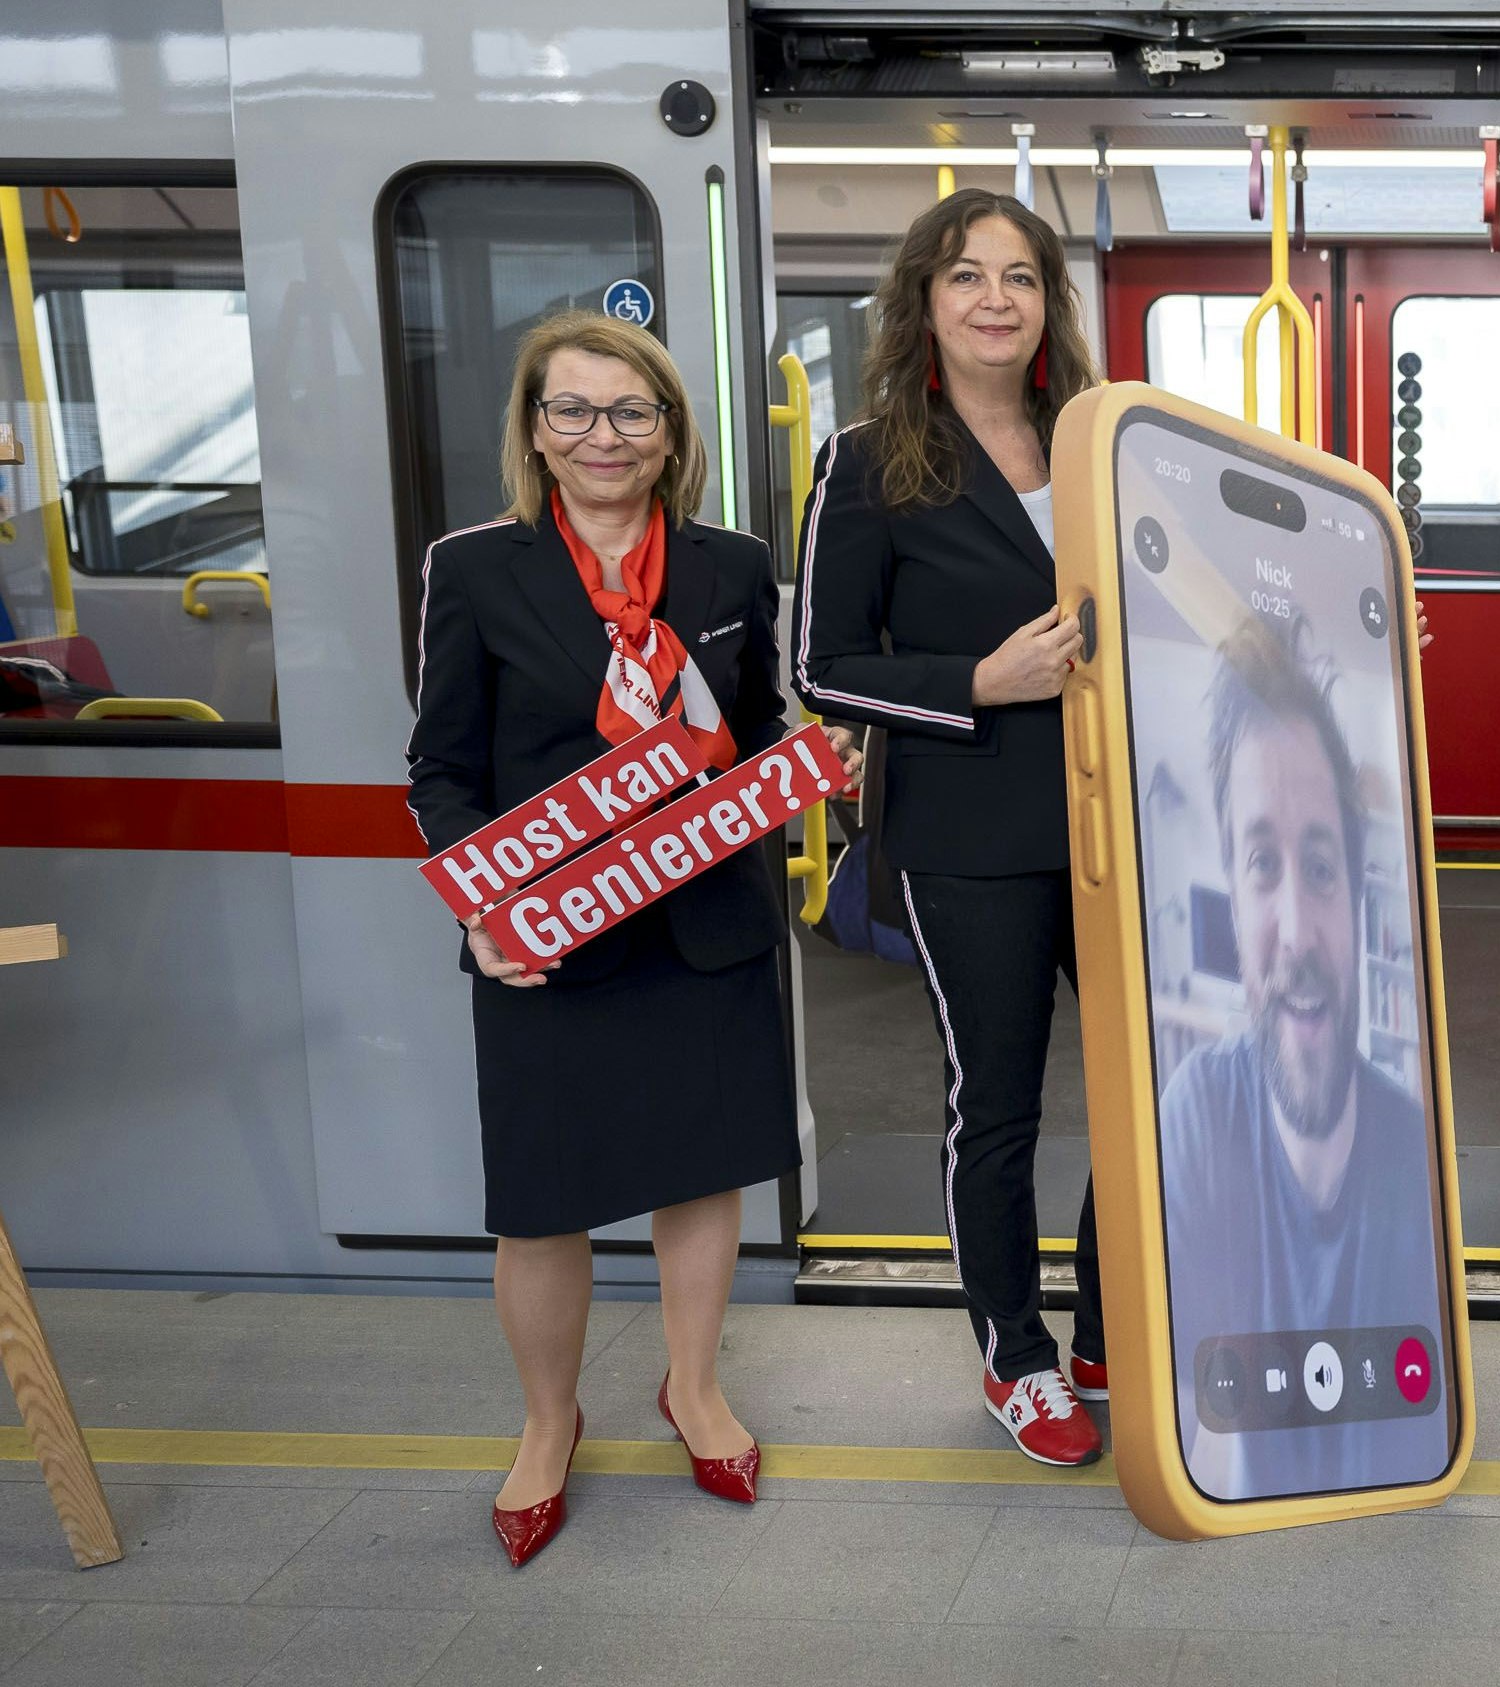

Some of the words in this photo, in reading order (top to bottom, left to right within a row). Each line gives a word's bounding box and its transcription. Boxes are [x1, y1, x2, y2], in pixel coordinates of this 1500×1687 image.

[1155, 458, 1191, 483] 20:20
[1338, 522, 1352, 539] 5G
[1255, 557, 1293, 590] Nick
[1251, 590, 1290, 619] 00:25
[442, 798, 587, 904] Host
[577, 742, 689, 822] kan
[509, 739, 831, 958] Genierer?!
